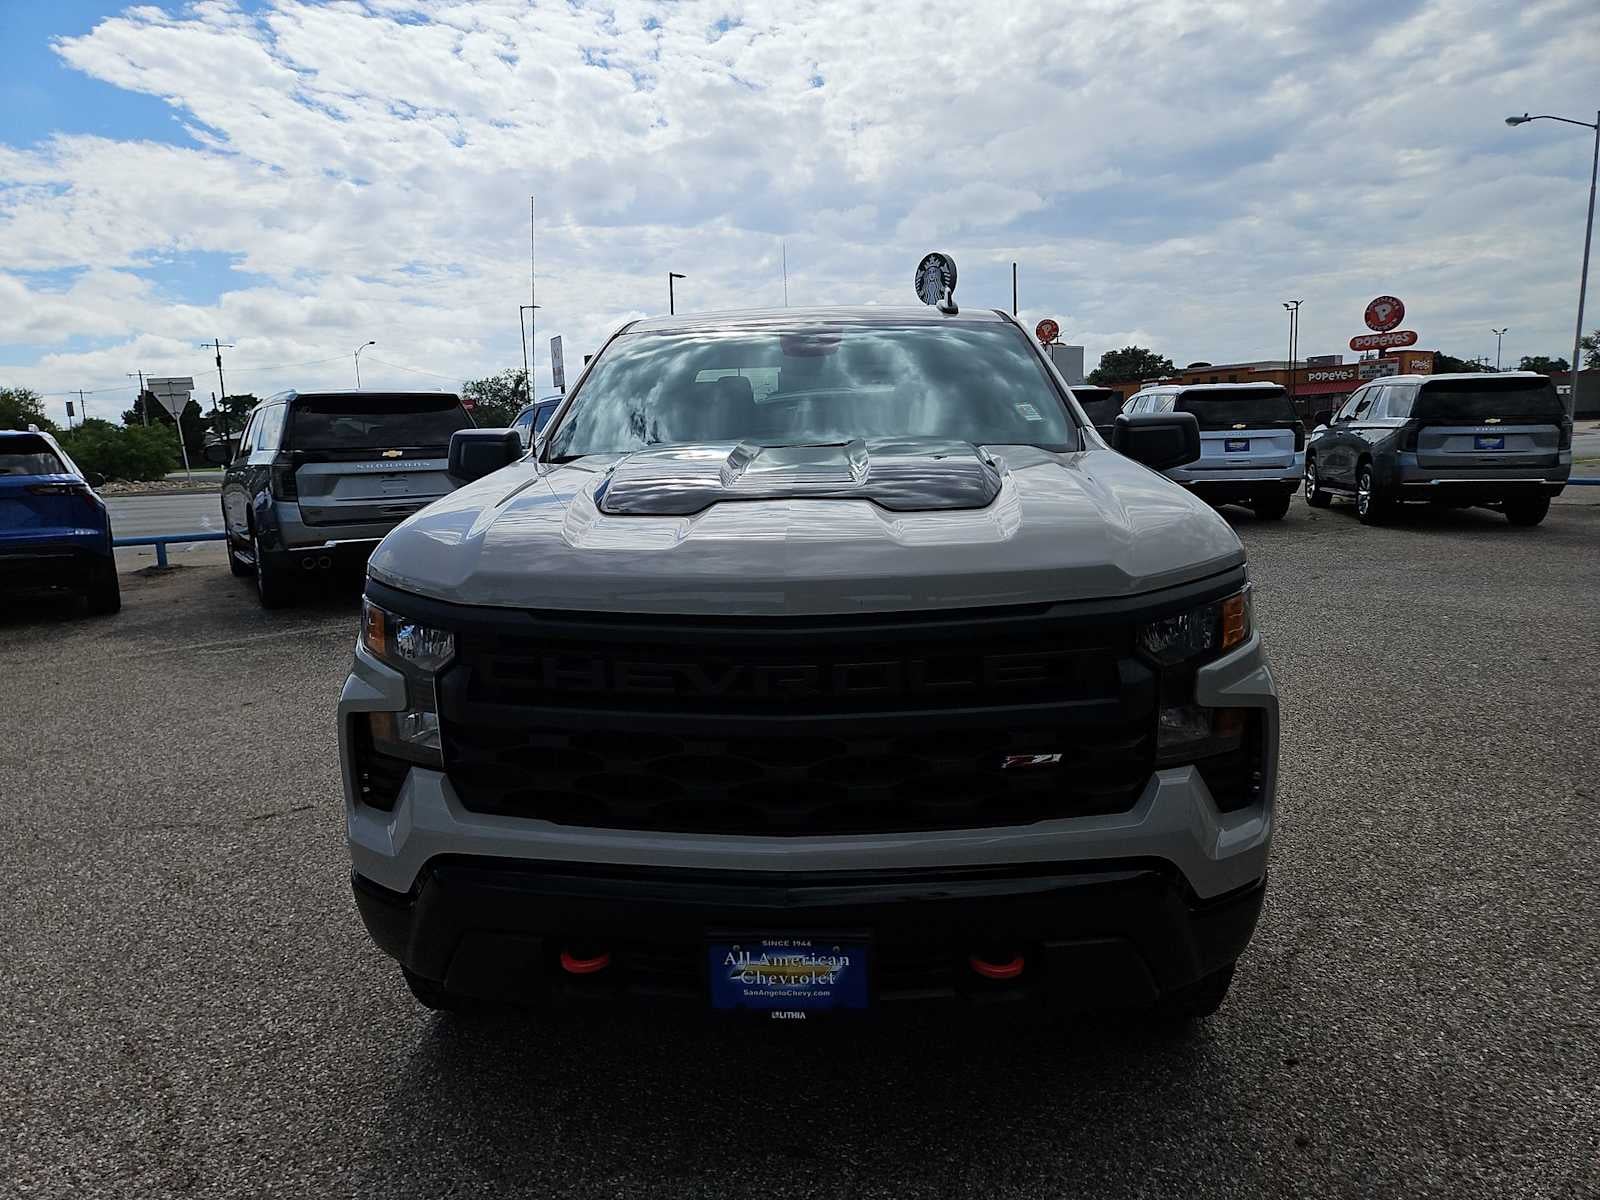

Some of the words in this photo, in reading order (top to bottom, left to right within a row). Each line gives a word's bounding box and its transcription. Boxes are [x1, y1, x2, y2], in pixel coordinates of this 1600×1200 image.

[724, 951, 750, 965] All
[759, 952, 849, 966] American
[740, 970, 835, 985] Chevrolet
[743, 989, 831, 998] SanAngeloChevy.com
